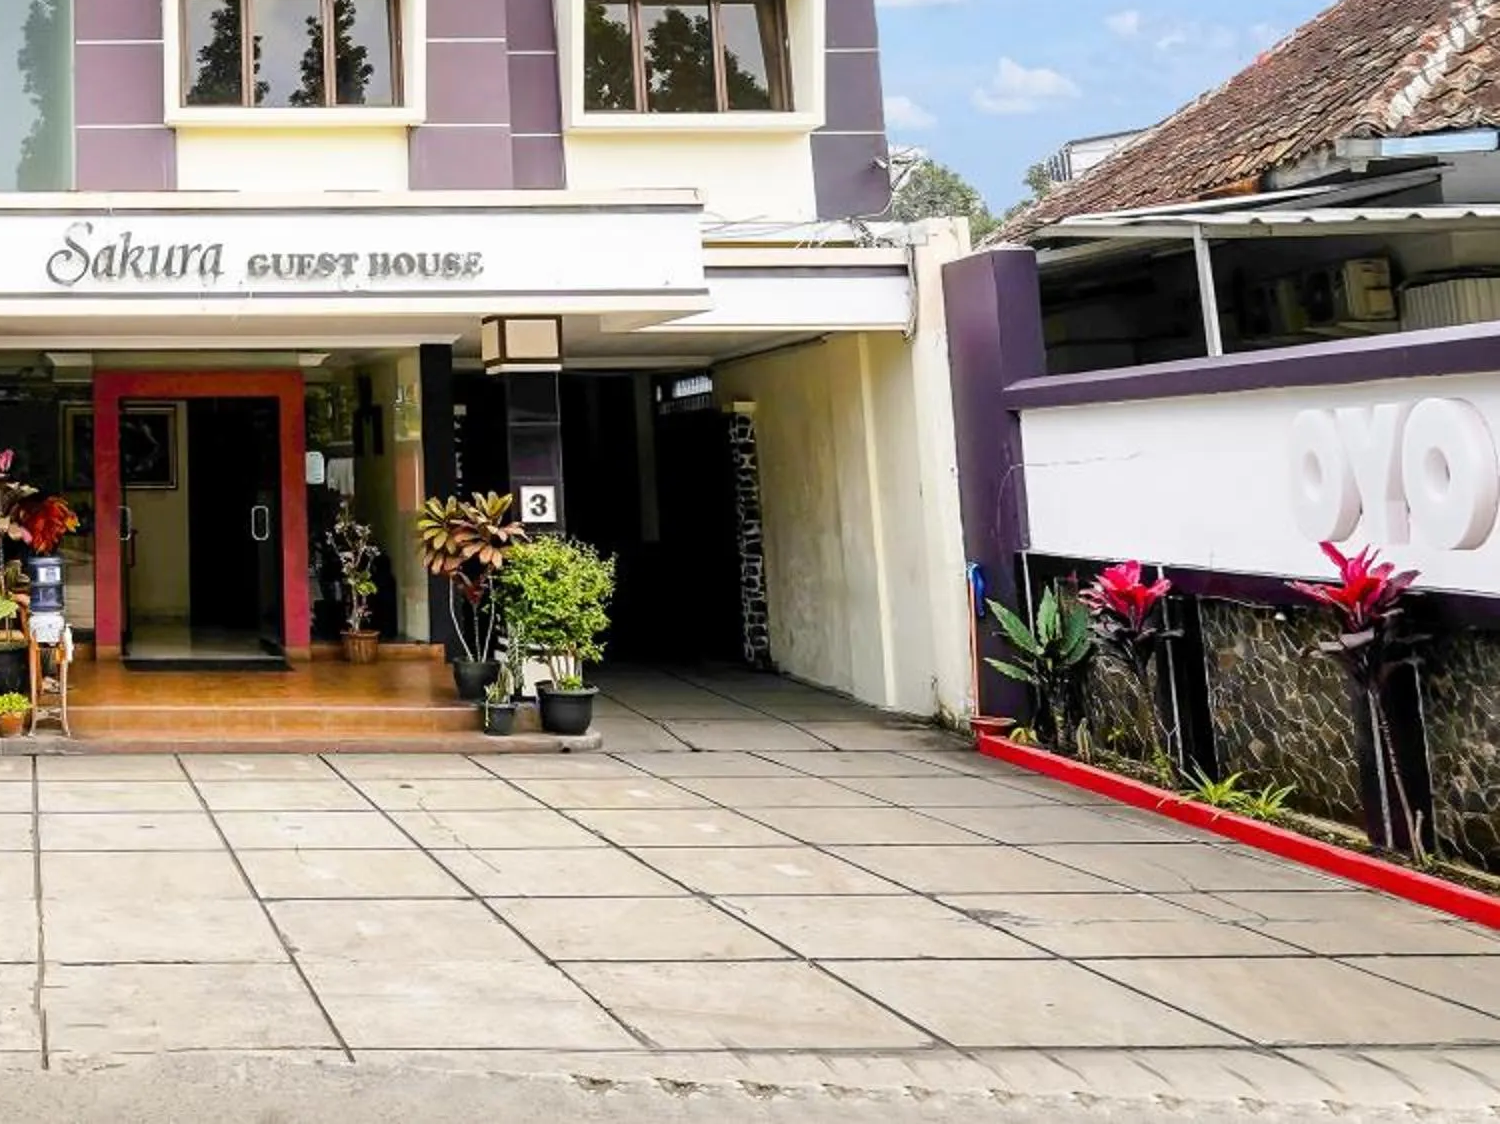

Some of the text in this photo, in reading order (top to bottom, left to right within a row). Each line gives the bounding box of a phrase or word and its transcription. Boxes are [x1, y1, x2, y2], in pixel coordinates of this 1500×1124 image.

[47, 222, 484, 286] Sakura GUEST HOUSE
[530, 493, 548, 517] 3
[1291, 397, 1499, 550] OYO
